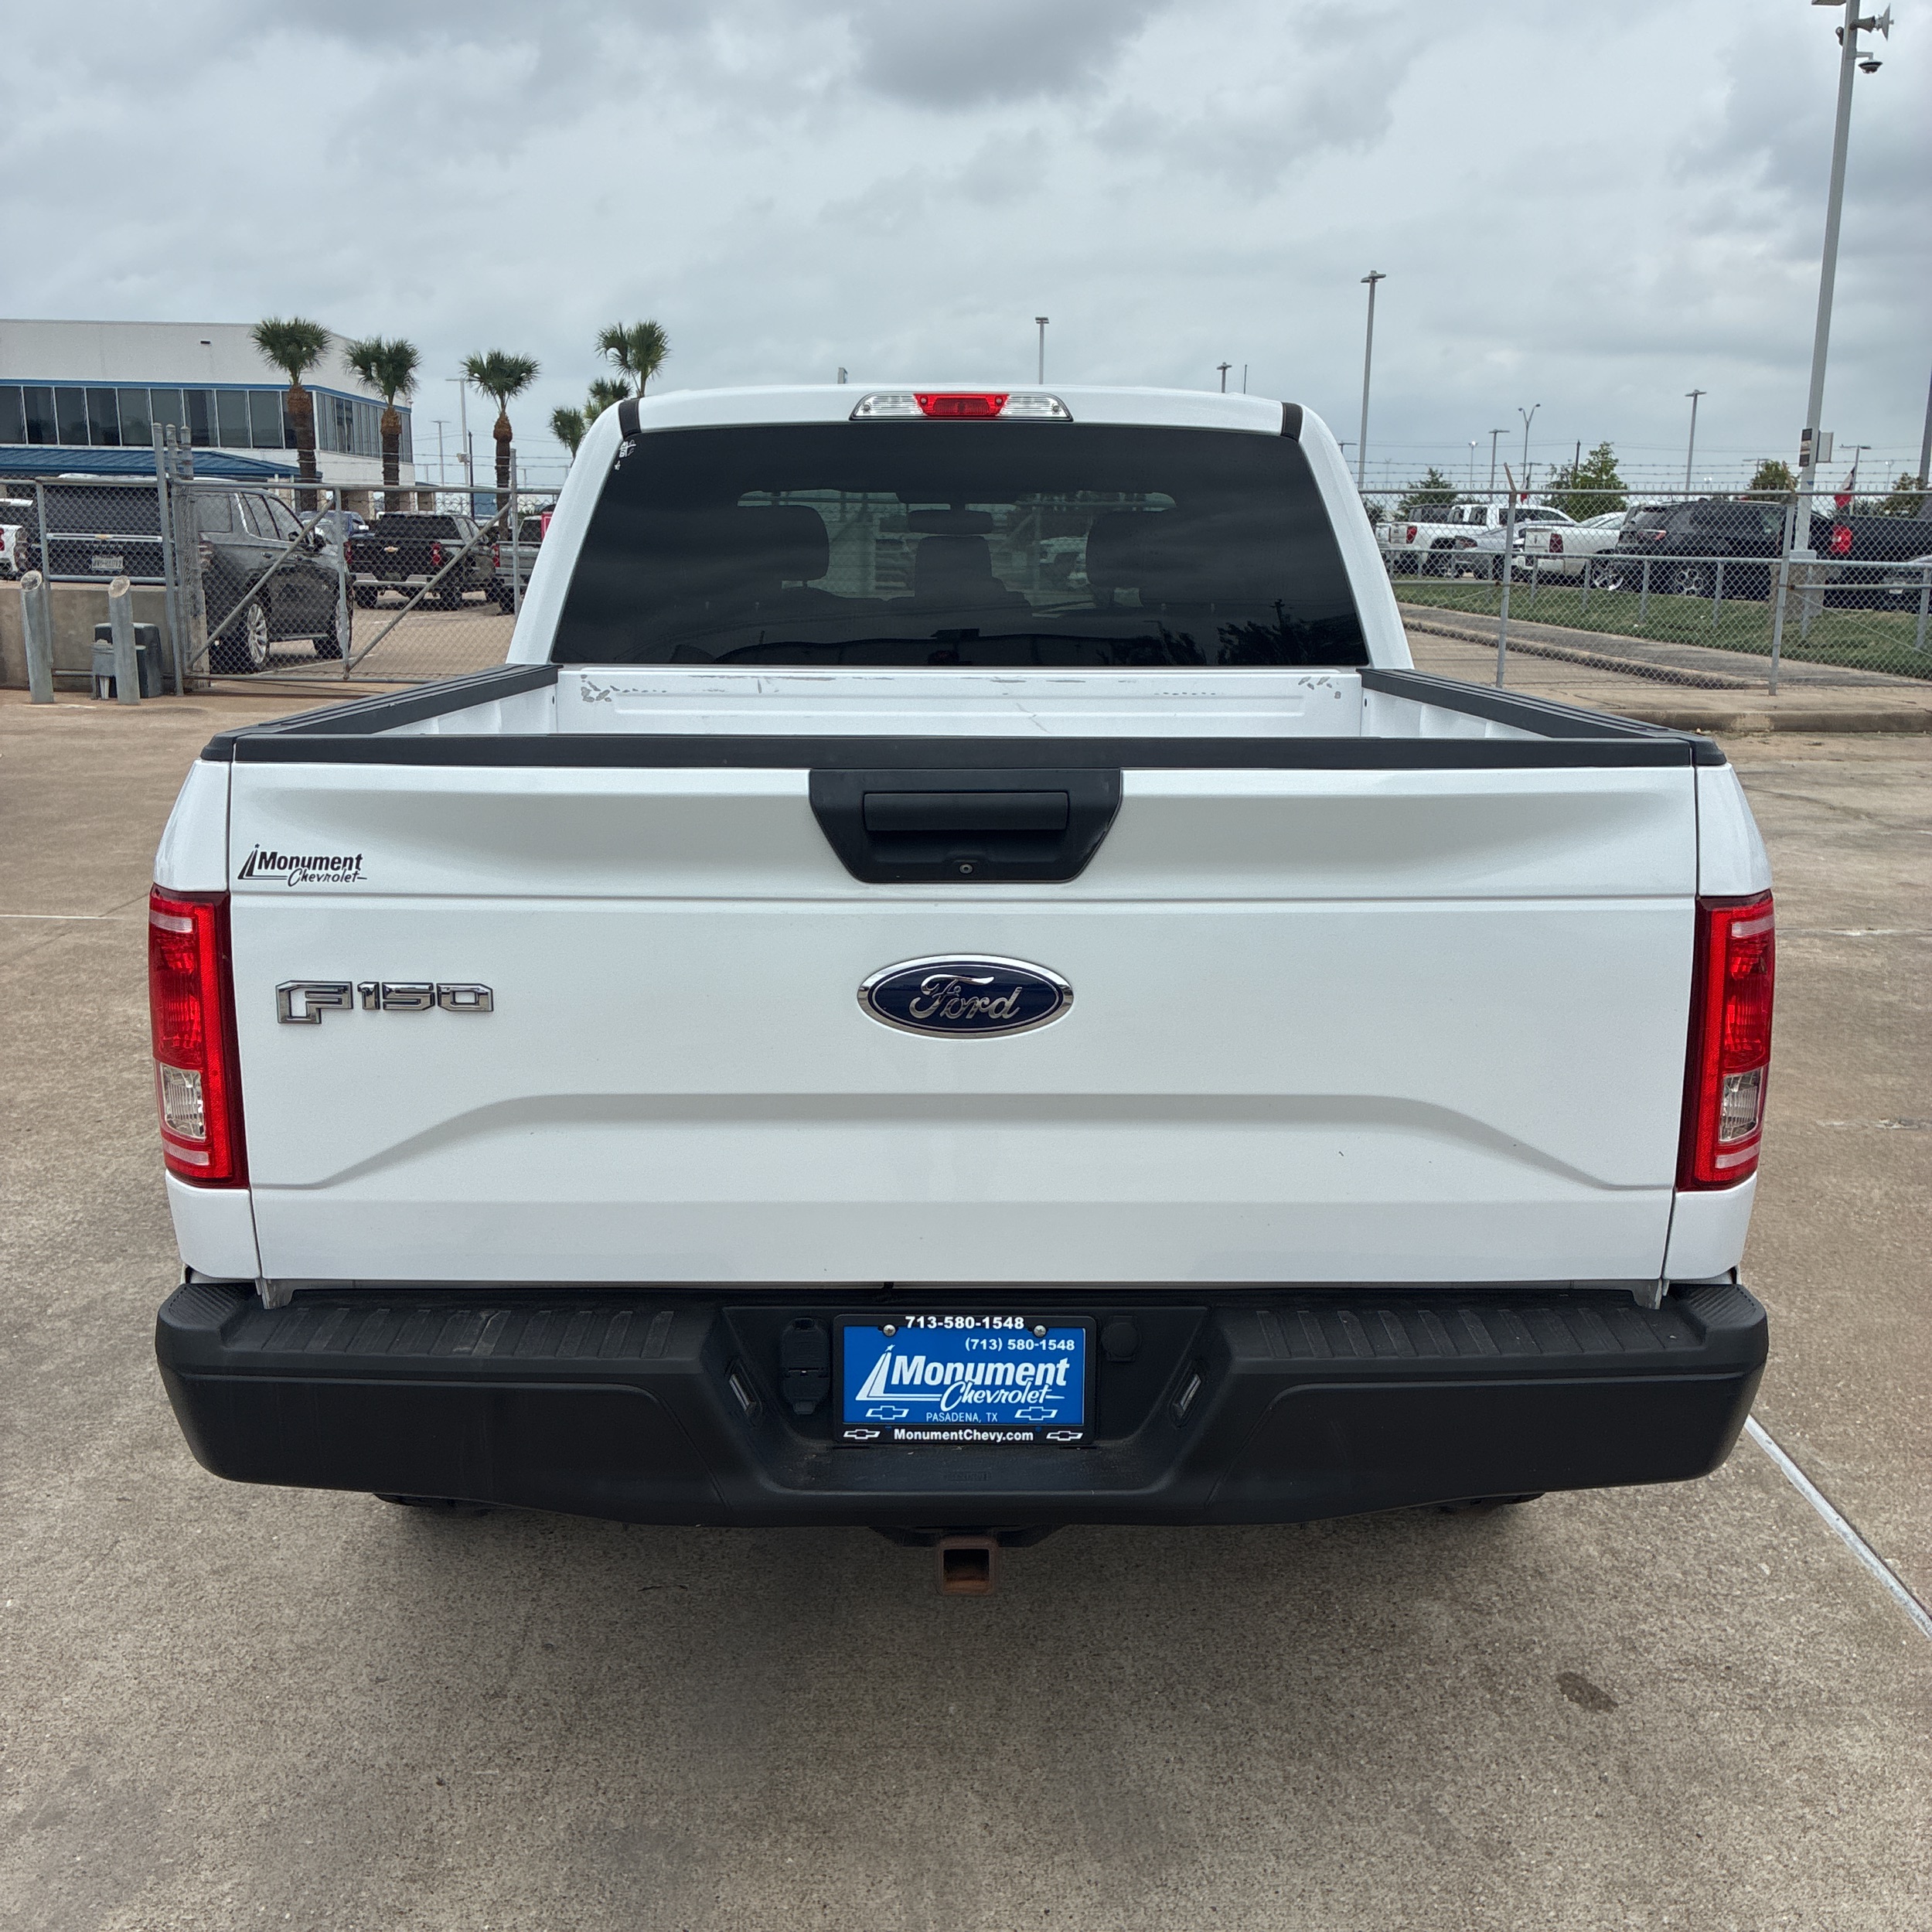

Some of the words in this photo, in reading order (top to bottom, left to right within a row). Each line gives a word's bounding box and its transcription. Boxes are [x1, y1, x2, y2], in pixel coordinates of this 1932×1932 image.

[257, 851, 363, 871] Monument
[288, 867, 367, 887] Chevrolet
[275, 980, 494, 1024] F150
[908, 973, 1023, 1019] Ford
[905, 1316, 1024, 1330] 713-580-1548
[965, 1337, 1003, 1352] (713)
[1007, 1338, 1075, 1351] 580-1548
[891, 1355, 1070, 1386] Monument
[940, 1378, 1065, 1411] Chevrolet
[925, 1412, 982, 1423] PASADENA,
[986, 1412, 998, 1423] TX
[894, 1428, 1034, 1443] MonumentChevy.com
